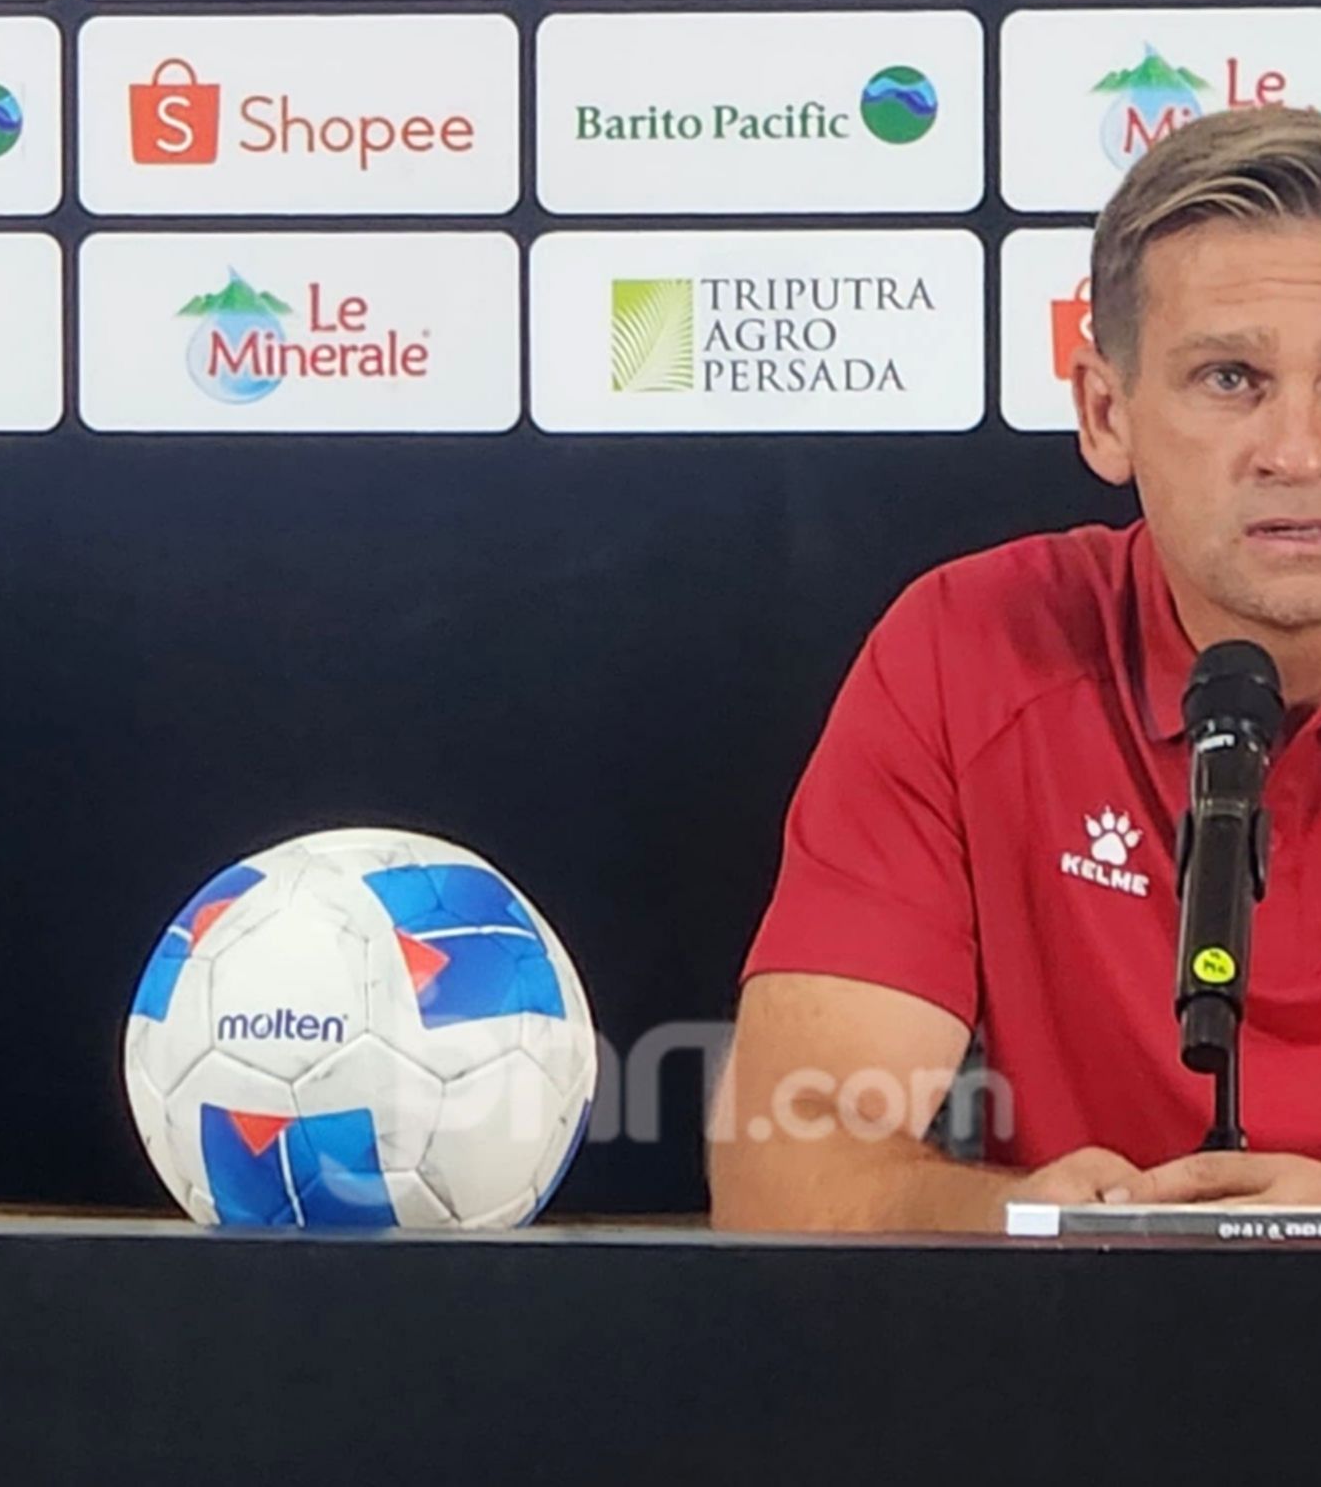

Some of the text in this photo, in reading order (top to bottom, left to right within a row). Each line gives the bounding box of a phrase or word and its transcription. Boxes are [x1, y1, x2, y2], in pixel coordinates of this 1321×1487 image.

[1227, 59, 1285, 108] Le
[239, 95, 474, 171] Shopee
[576, 101, 849, 140] Barito Pacific
[309, 286, 366, 333] Le
[701, 278, 934, 311] TRIPUTRA
[208, 331, 427, 377] Minerale
[704, 318, 836, 351] AGRO
[704, 359, 905, 392] PERSADA
[1061, 852, 1149, 898] KELME
[218, 1008, 344, 1043] molten
